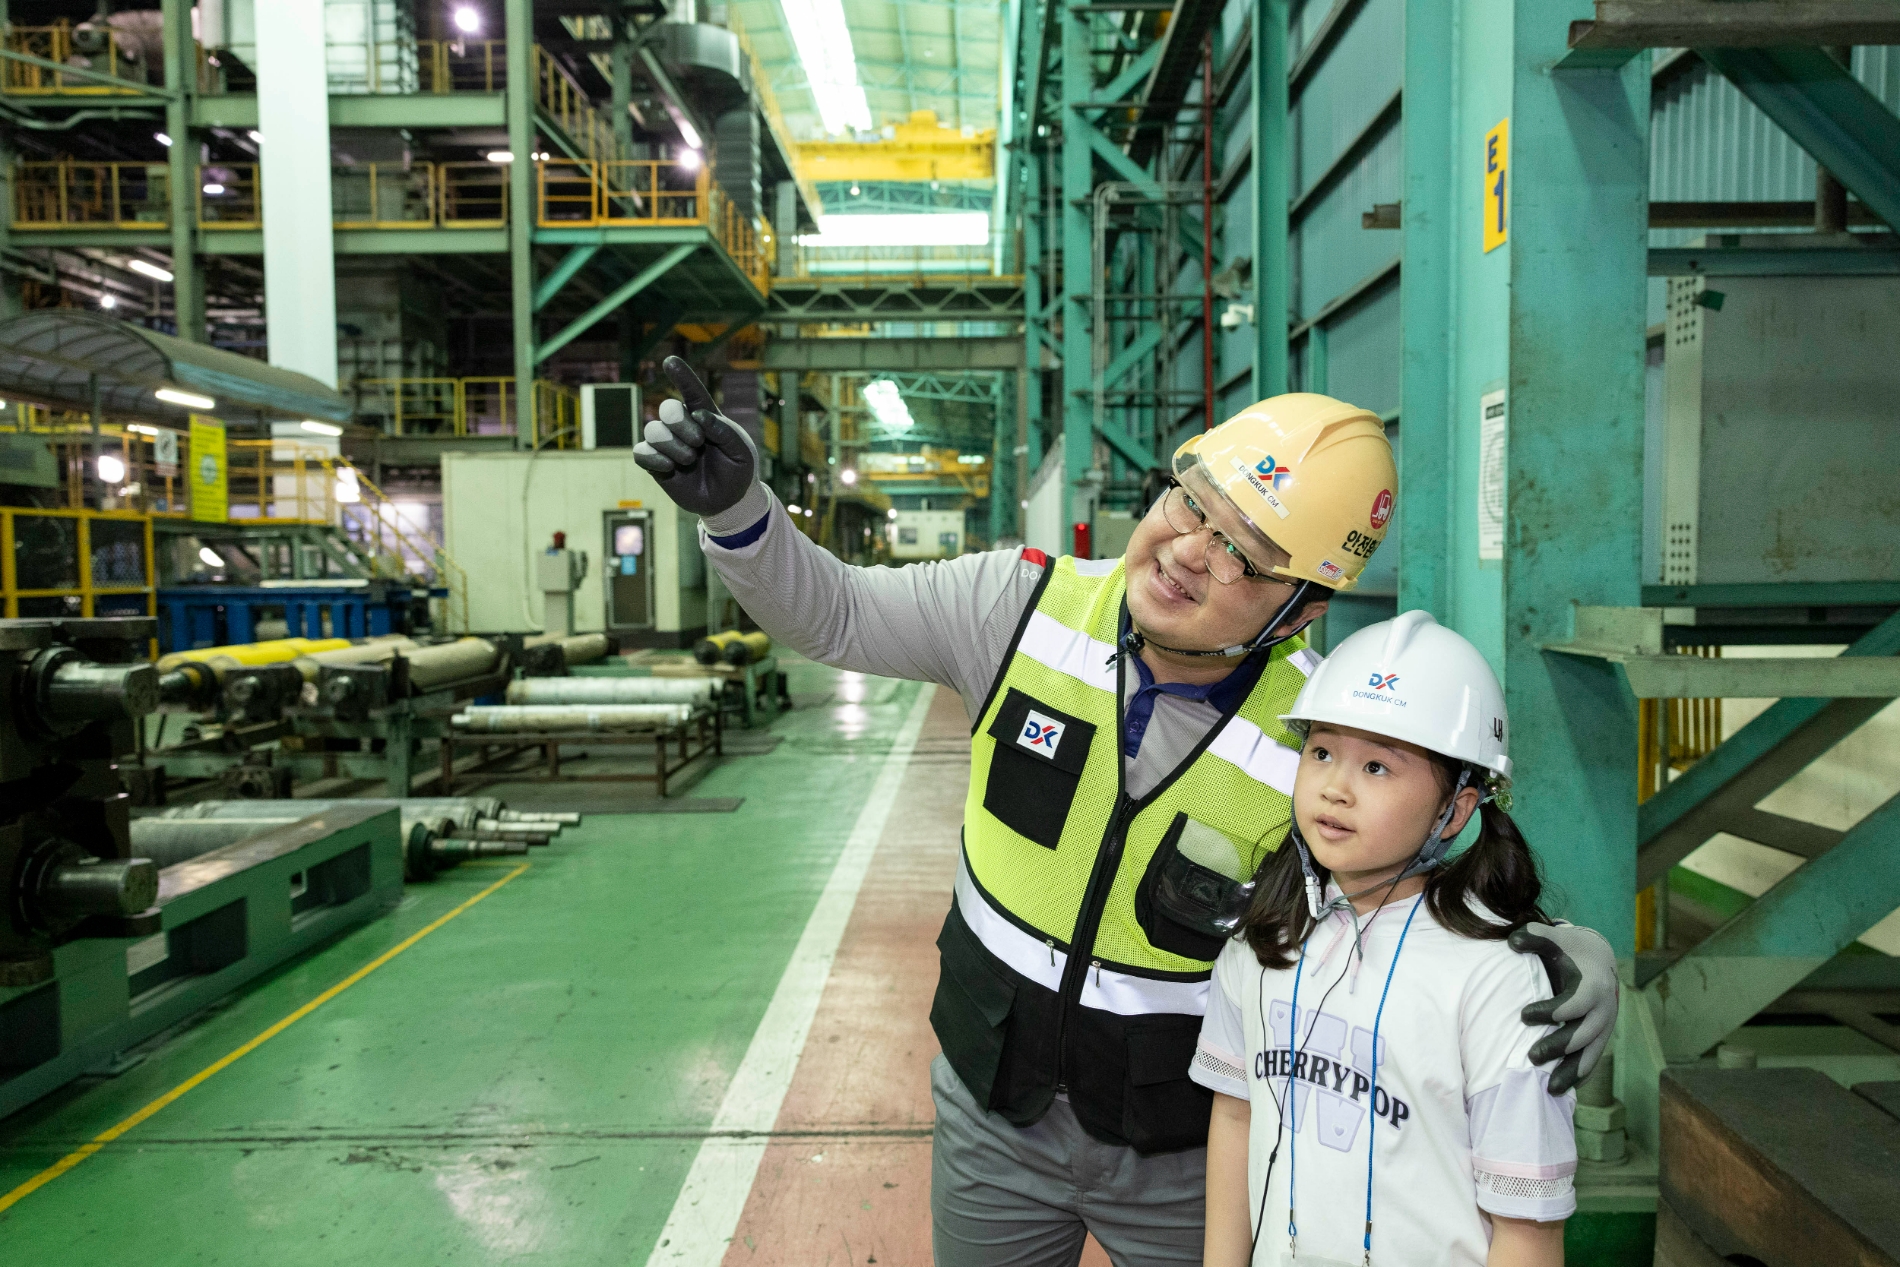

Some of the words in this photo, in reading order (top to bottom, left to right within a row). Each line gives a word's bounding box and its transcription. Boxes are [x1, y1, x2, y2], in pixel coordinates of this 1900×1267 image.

[1487, 134, 1498, 173] E
[1494, 169, 1505, 233] 1
[1238, 465, 1269, 497] DONGKUK
[1267, 495, 1280, 508] CM
[1353, 690, 1393, 703] DONGKUK
[1394, 699, 1407, 707] CM
[1255, 1050, 1410, 1129] CHERRYPOP
